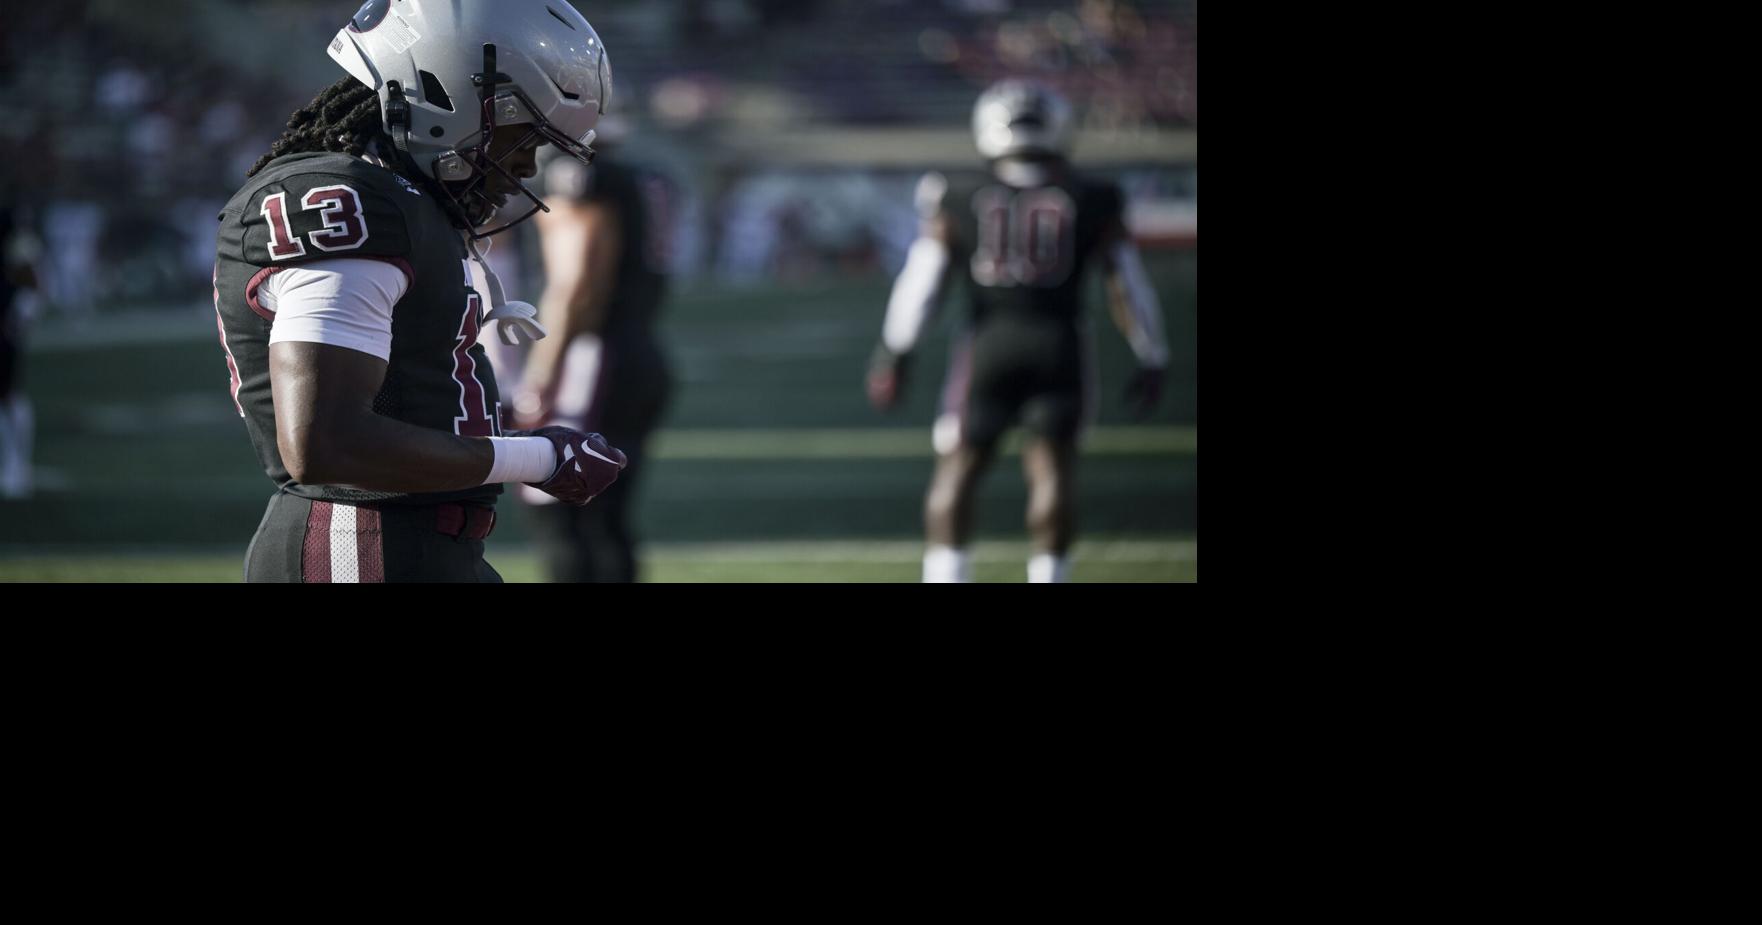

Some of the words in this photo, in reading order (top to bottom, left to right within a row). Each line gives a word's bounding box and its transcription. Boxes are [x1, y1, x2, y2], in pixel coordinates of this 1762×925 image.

[260, 185, 369, 261] 13
[970, 186, 1077, 288] 10
[452, 294, 503, 438] 1
